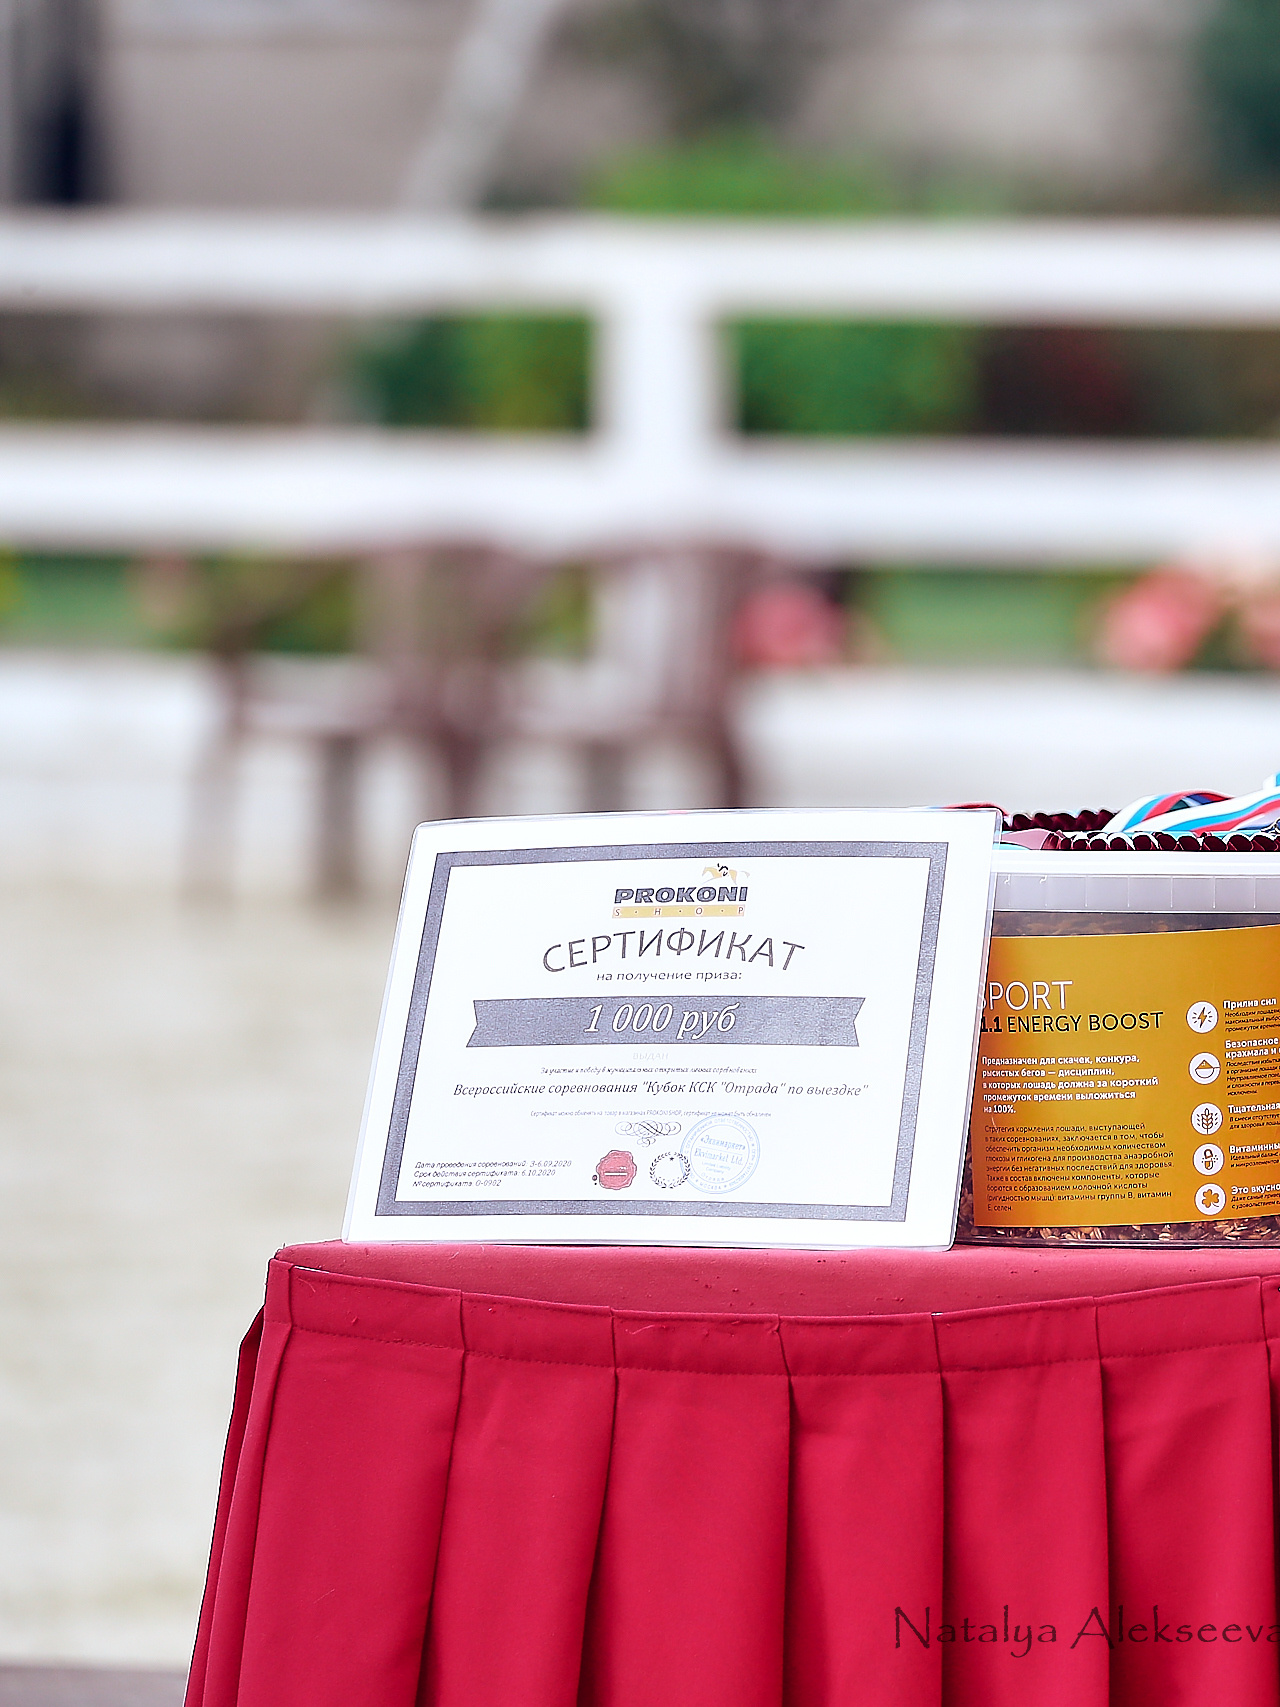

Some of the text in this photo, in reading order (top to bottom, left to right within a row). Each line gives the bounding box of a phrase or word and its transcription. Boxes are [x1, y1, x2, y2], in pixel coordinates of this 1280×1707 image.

[614, 886, 748, 903] PROKONI
[543, 927, 805, 972] СЕРТИФИКАТ
[597, 971, 742, 983] на получение приза:
[1223, 1000, 1259, 1010] Прилив
[1260, 998, 1277, 1006] сил
[584, 1002, 740, 1040] 1 000 руб
[1008, 1015, 1082, 1032] ENERGY
[1089, 1011, 1163, 1031] BOOST
[1225, 1037, 1279, 1049] Безопасное
[1225, 1048, 1269, 1059] крахмала
[982, 1057, 1038, 1066] Предназначен
[1040, 1057, 1055, 1065] для
[982, 1070, 1019, 1078] рысистых
[1021, 1068, 1045, 1077] бегов
[453, 1083, 545, 1098] Всероссийские
[548, 1084, 637, 1096] соревнования
[643, 1082, 688, 1095] "Кубок
[689, 1082, 718, 1093] КСК
[787, 1086, 803, 1094] по
[989, 1082, 1021, 1091] которых
[1023, 1081, 1056, 1089] лошадь
[1058, 1080, 1094, 1089] должна
[1097, 1080, 1107, 1088] за
[1110, 1077, 1158, 1088] короткий
[983, 1091, 1136, 1103] промежуток времени выложиться
[1228, 1102, 1280, 1114] Тщательная
[1231, 1186, 1248, 1194] Это
